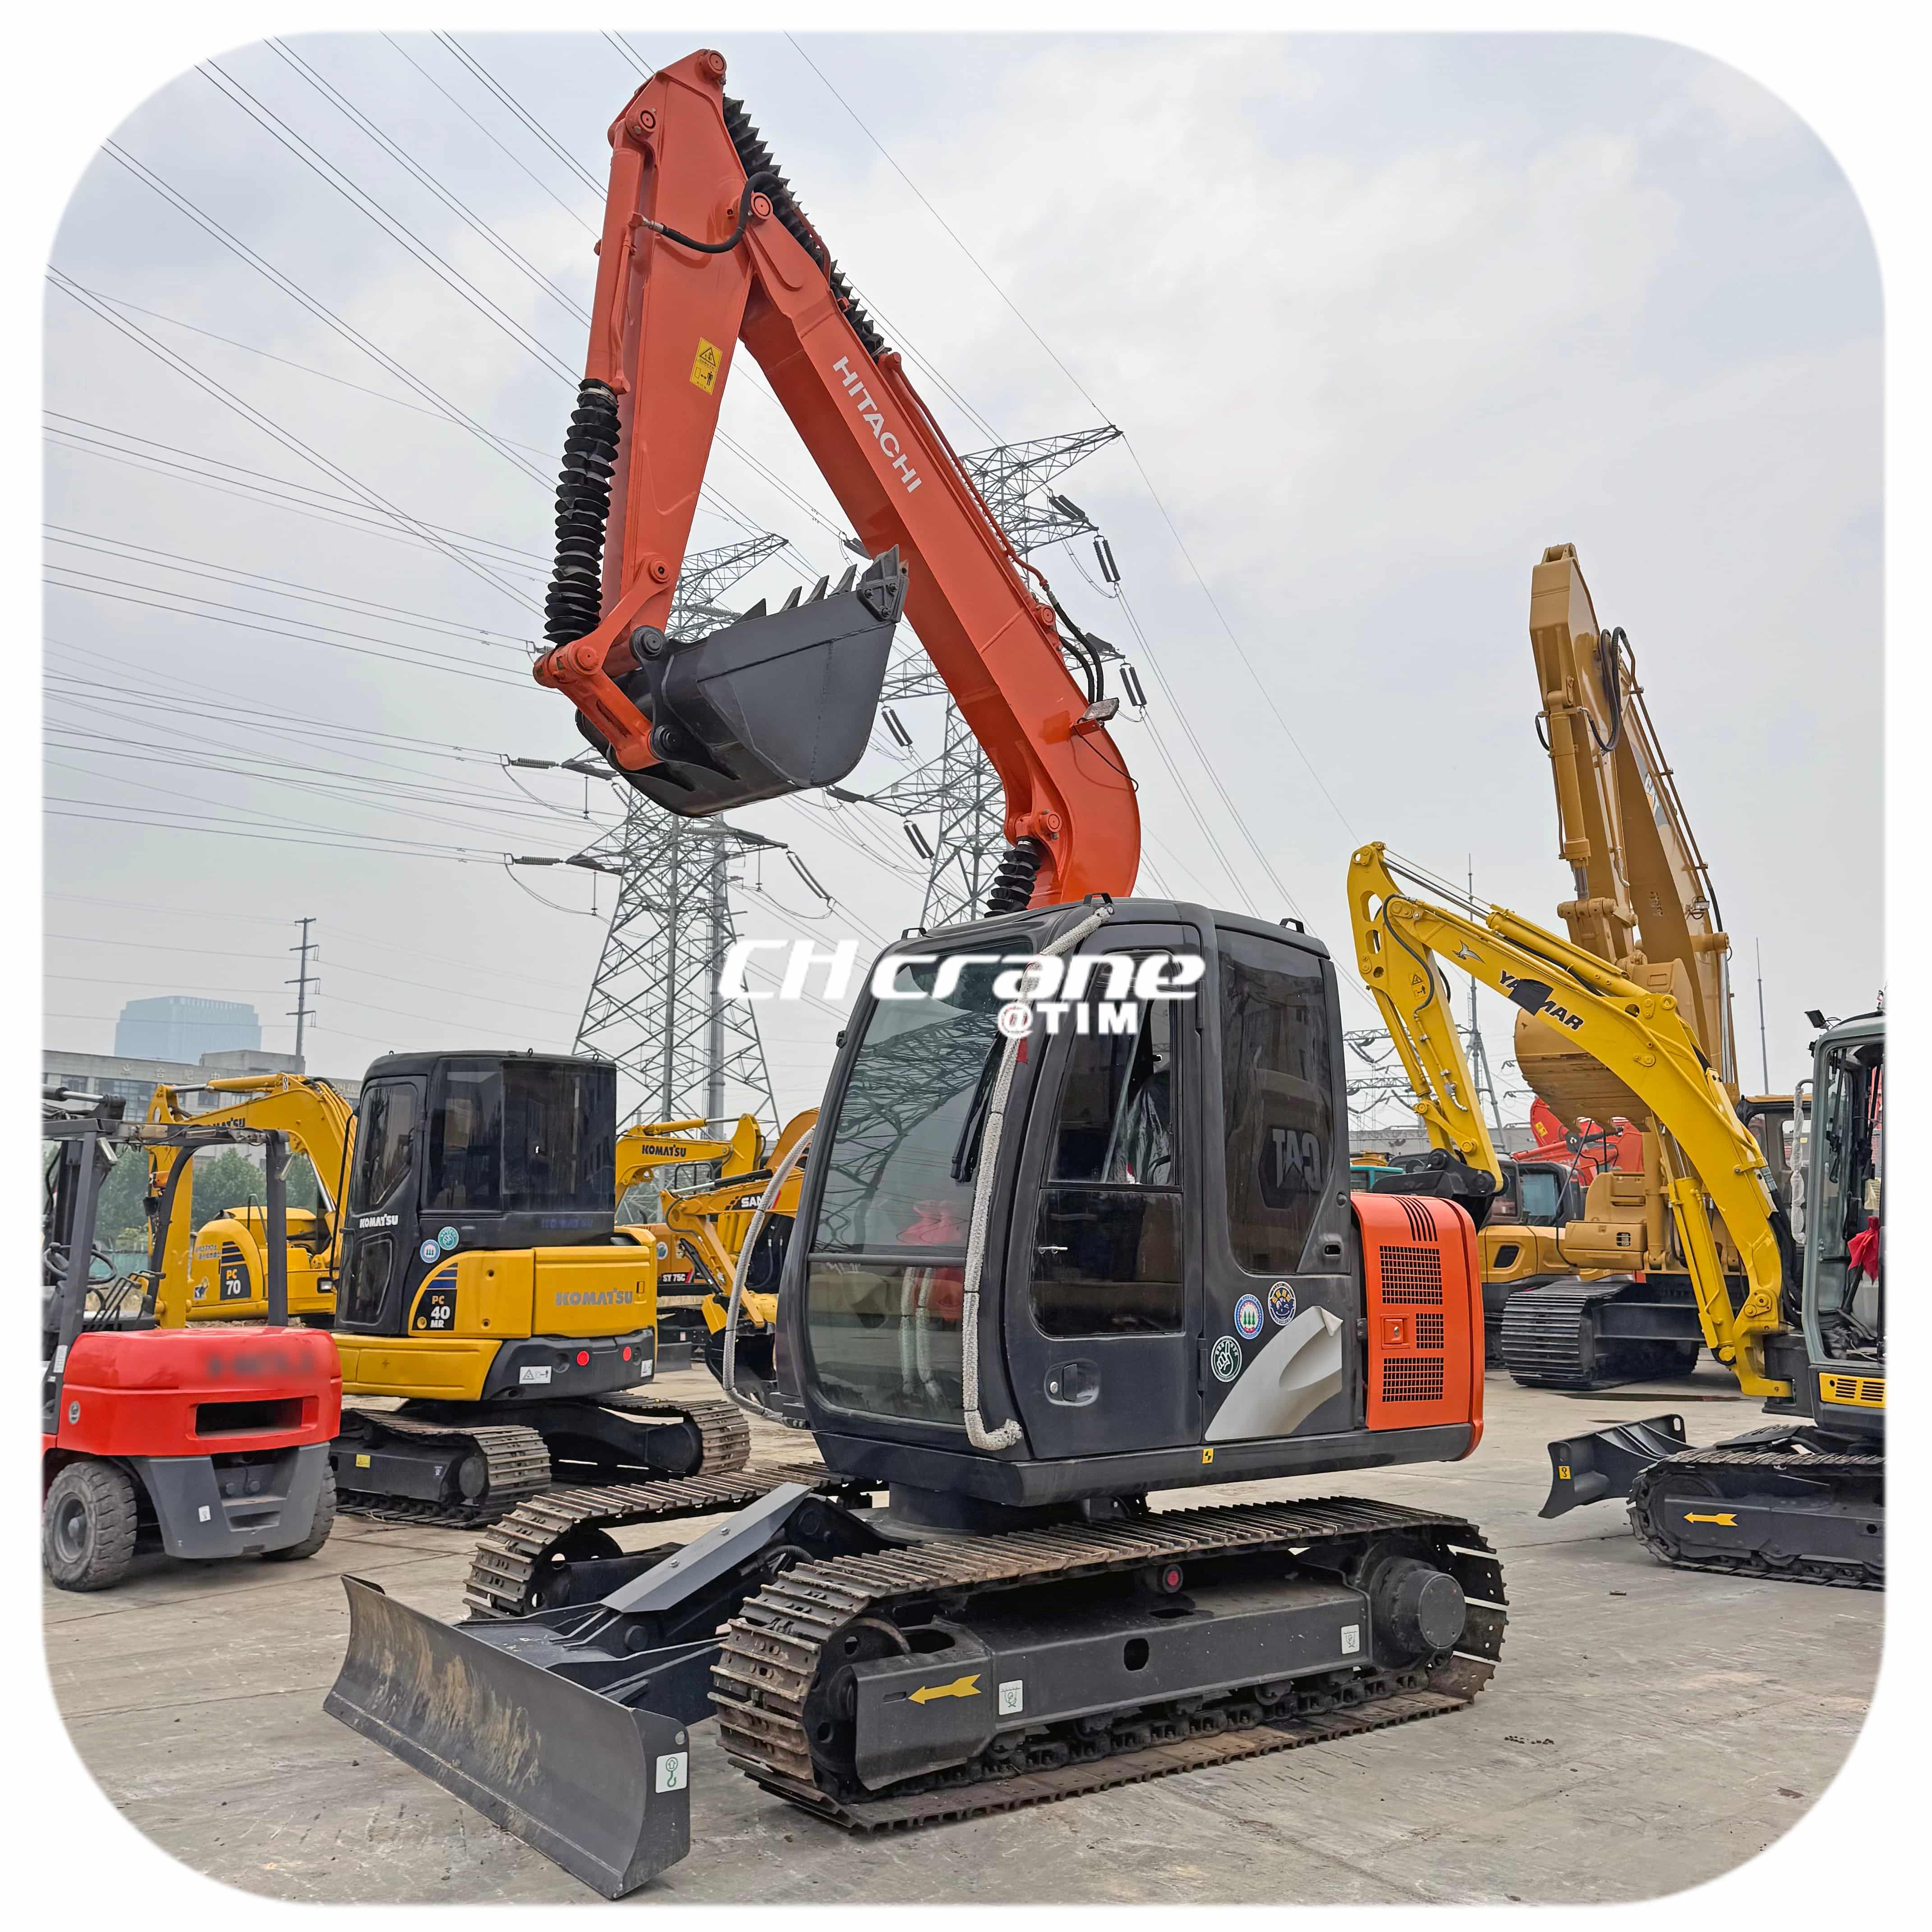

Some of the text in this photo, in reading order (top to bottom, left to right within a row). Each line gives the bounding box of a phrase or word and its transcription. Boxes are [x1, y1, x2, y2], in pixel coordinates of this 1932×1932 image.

[833, 356, 922, 493] HITACHI
[1500, 969, 1584, 1030] YAMAR
[642, 1144, 686, 1157] KOMATSU
[741, 1193, 765, 1208] SAN
[359, 1214, 398, 1228] KOMATSU
[226, 1269, 237, 1279] PC
[672, 1274, 685, 1282] 75C
[226, 1280, 241, 1295] 70
[432, 1295, 445, 1305] PC
[555, 1288, 633, 1306] KOMATSU
[431, 1306, 450, 1319] 40
[430, 1320, 444, 1328] MR
